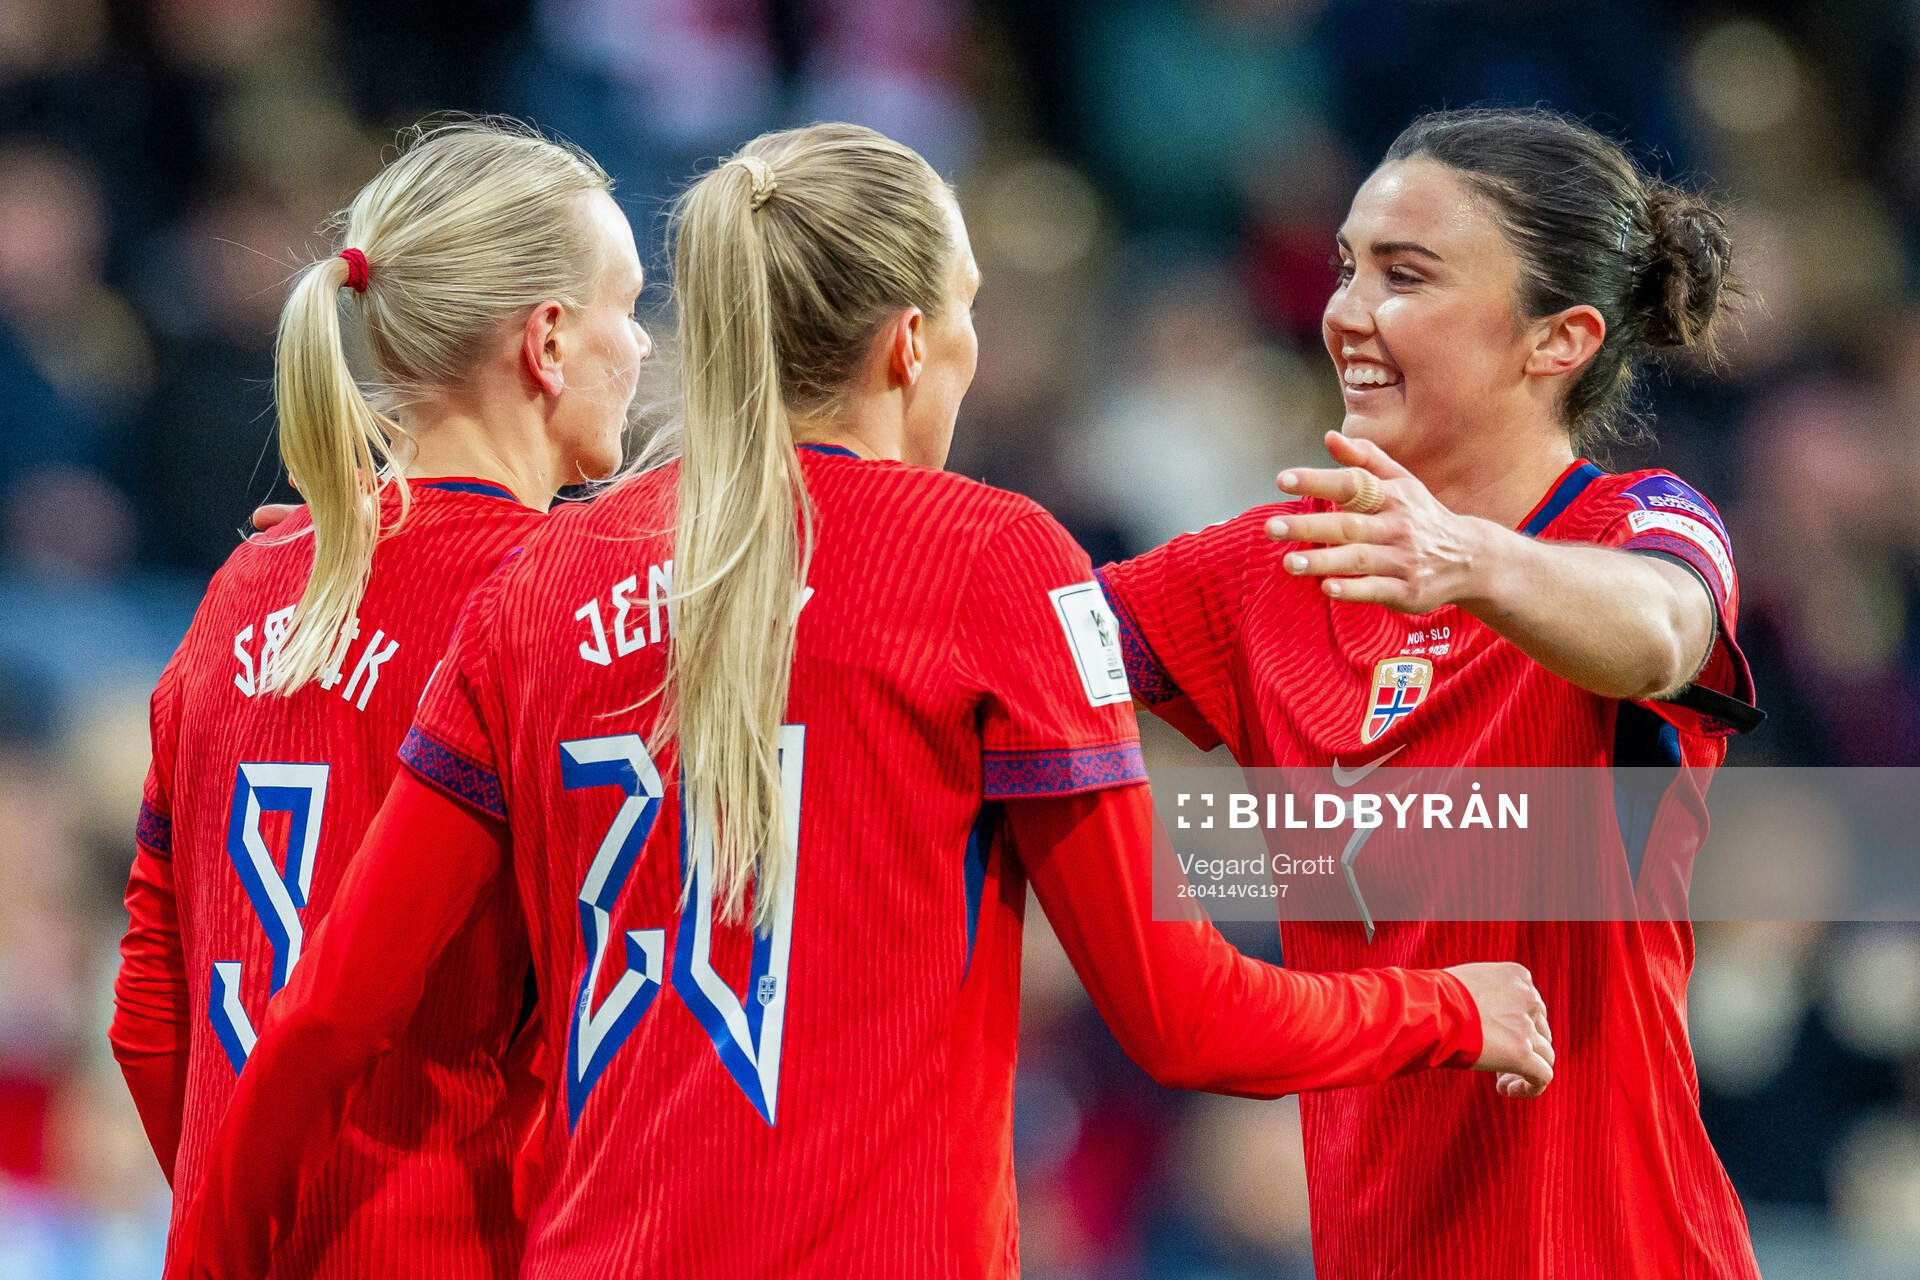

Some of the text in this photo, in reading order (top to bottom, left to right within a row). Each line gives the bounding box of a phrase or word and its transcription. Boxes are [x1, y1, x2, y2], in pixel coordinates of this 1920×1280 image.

[575, 560, 815, 666] JEN
[1407, 631, 1425, 645] NOR
[1430, 626, 1450, 640] SLO
[207, 762, 330, 1078] 9
[559, 723, 806, 1138] 20
